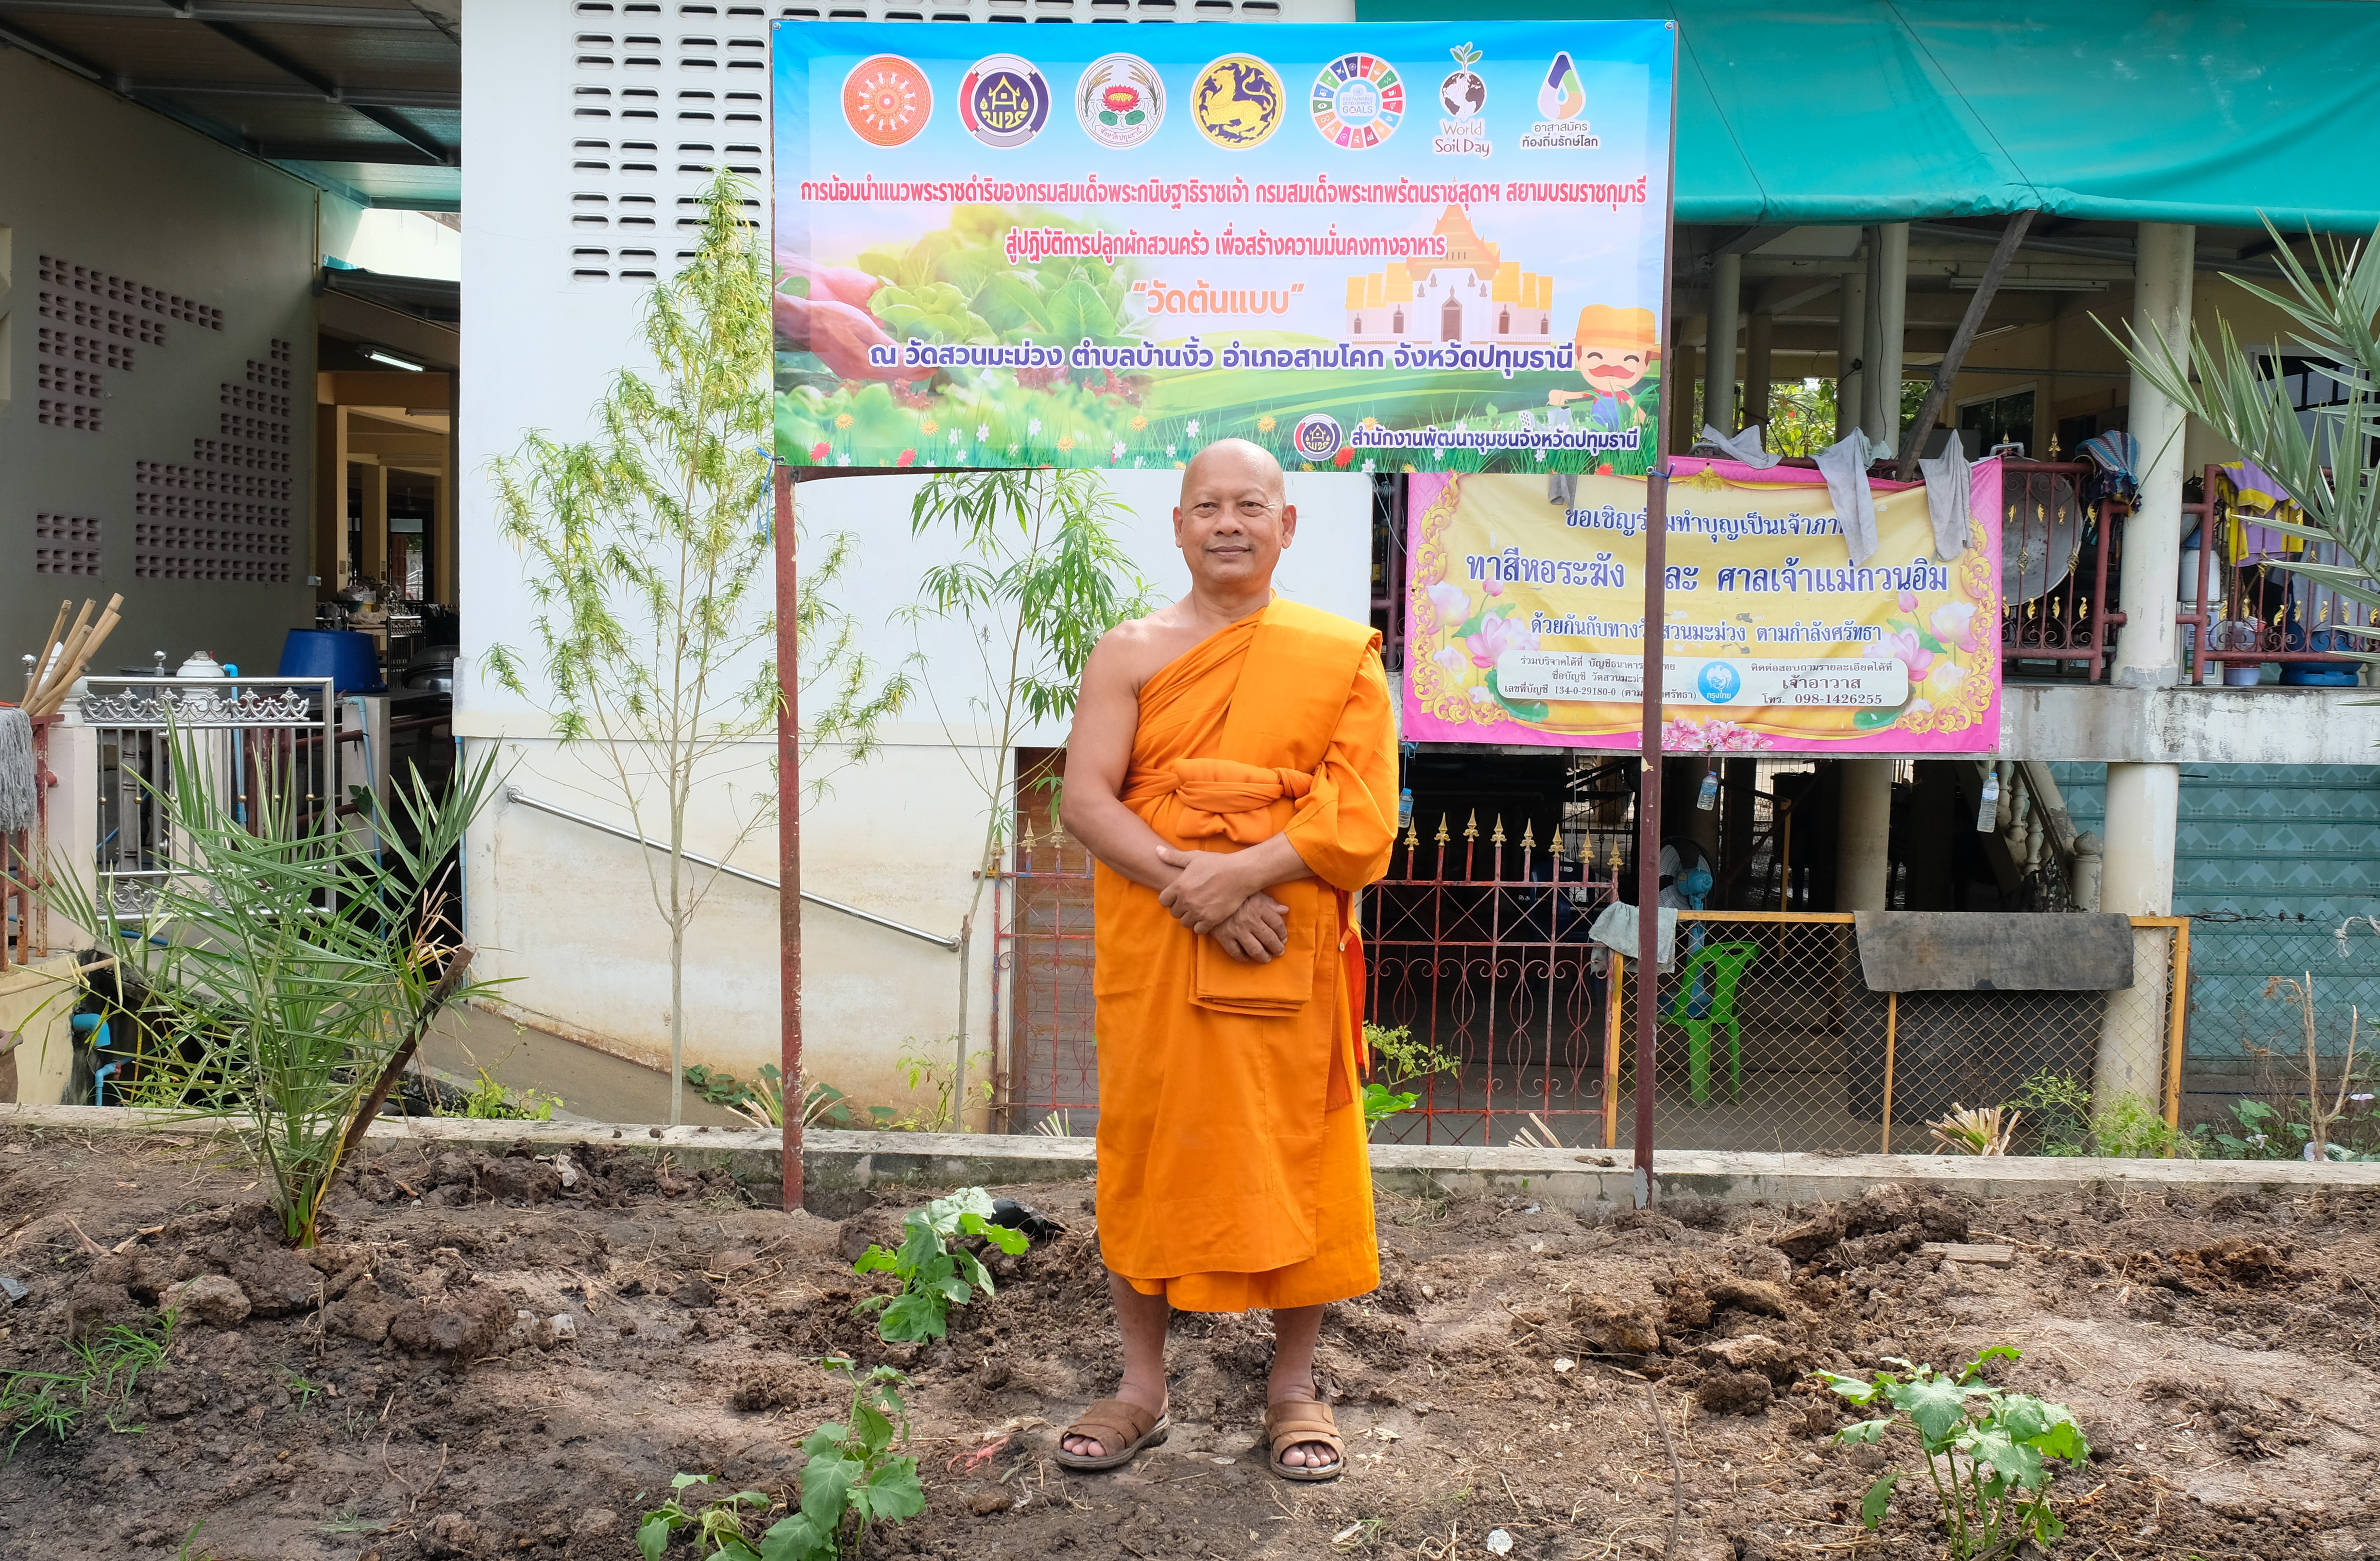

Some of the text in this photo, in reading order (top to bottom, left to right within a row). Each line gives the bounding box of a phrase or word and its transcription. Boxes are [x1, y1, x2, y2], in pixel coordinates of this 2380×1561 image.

[1443, 121, 1482, 136] World
[1534, 121, 1587, 132] อาสาสมัคร
[1435, 138, 1490, 157] Soil Day
[1522, 133, 1598, 147] ท้องถิ่นรักษ์โลก
[800, 174, 1646, 212] การน้อมนำแนวพระราชดำริของกรมสมเด็จพระกนิษฐาธิราชเจ้า กรมสมเด็จพระเทพรัตนราชสุดาฯ สยามบรมราชกุมารี
[1006, 222, 1445, 263] สู่ปฏิบัติการปลูกผักสวนครัว เพื่อสร้างความมั่นคงทางอาหาร
[871, 336, 1573, 376] ณ วัดสวนมะม่วง ตำบลบ้านงิ้ว อำเภอสามโคก จังหวัดปทุมธานี
[1352, 425, 1637, 454] สำนักงานพัฒนาชุมชนจังหวัดปทุมธานี
[1565, 505, 1844, 543] ขอเชิญร่มทำบุญเป็นเจ้าภา
[1466, 547, 1948, 592] ทาสีหอระฆัง ละ ศาลเจ้าแม่กวนอิม
[1756, 620, 1882, 642] ตามกำลังศรัทธา
[1520, 655, 1583, 667] ร่วมบริจาคได้ที่
[1751, 661, 1892, 672] ติดต่อสอบถามรายละเอียดได้ที่
[1551, 668, 1644, 683] ชื่อบัญชี วัดสวนมะม่ว
[1782, 675, 1861, 689] เจ้าอาวาส
[1504, 681, 1548, 696] เลขที่บัญชี
[1555, 686, 1616, 696] 134-0-29180-0
[1707, 690, 1732, 701] กรุงไทย
[1762, 693, 1883, 704] โทร. 098-1426255
